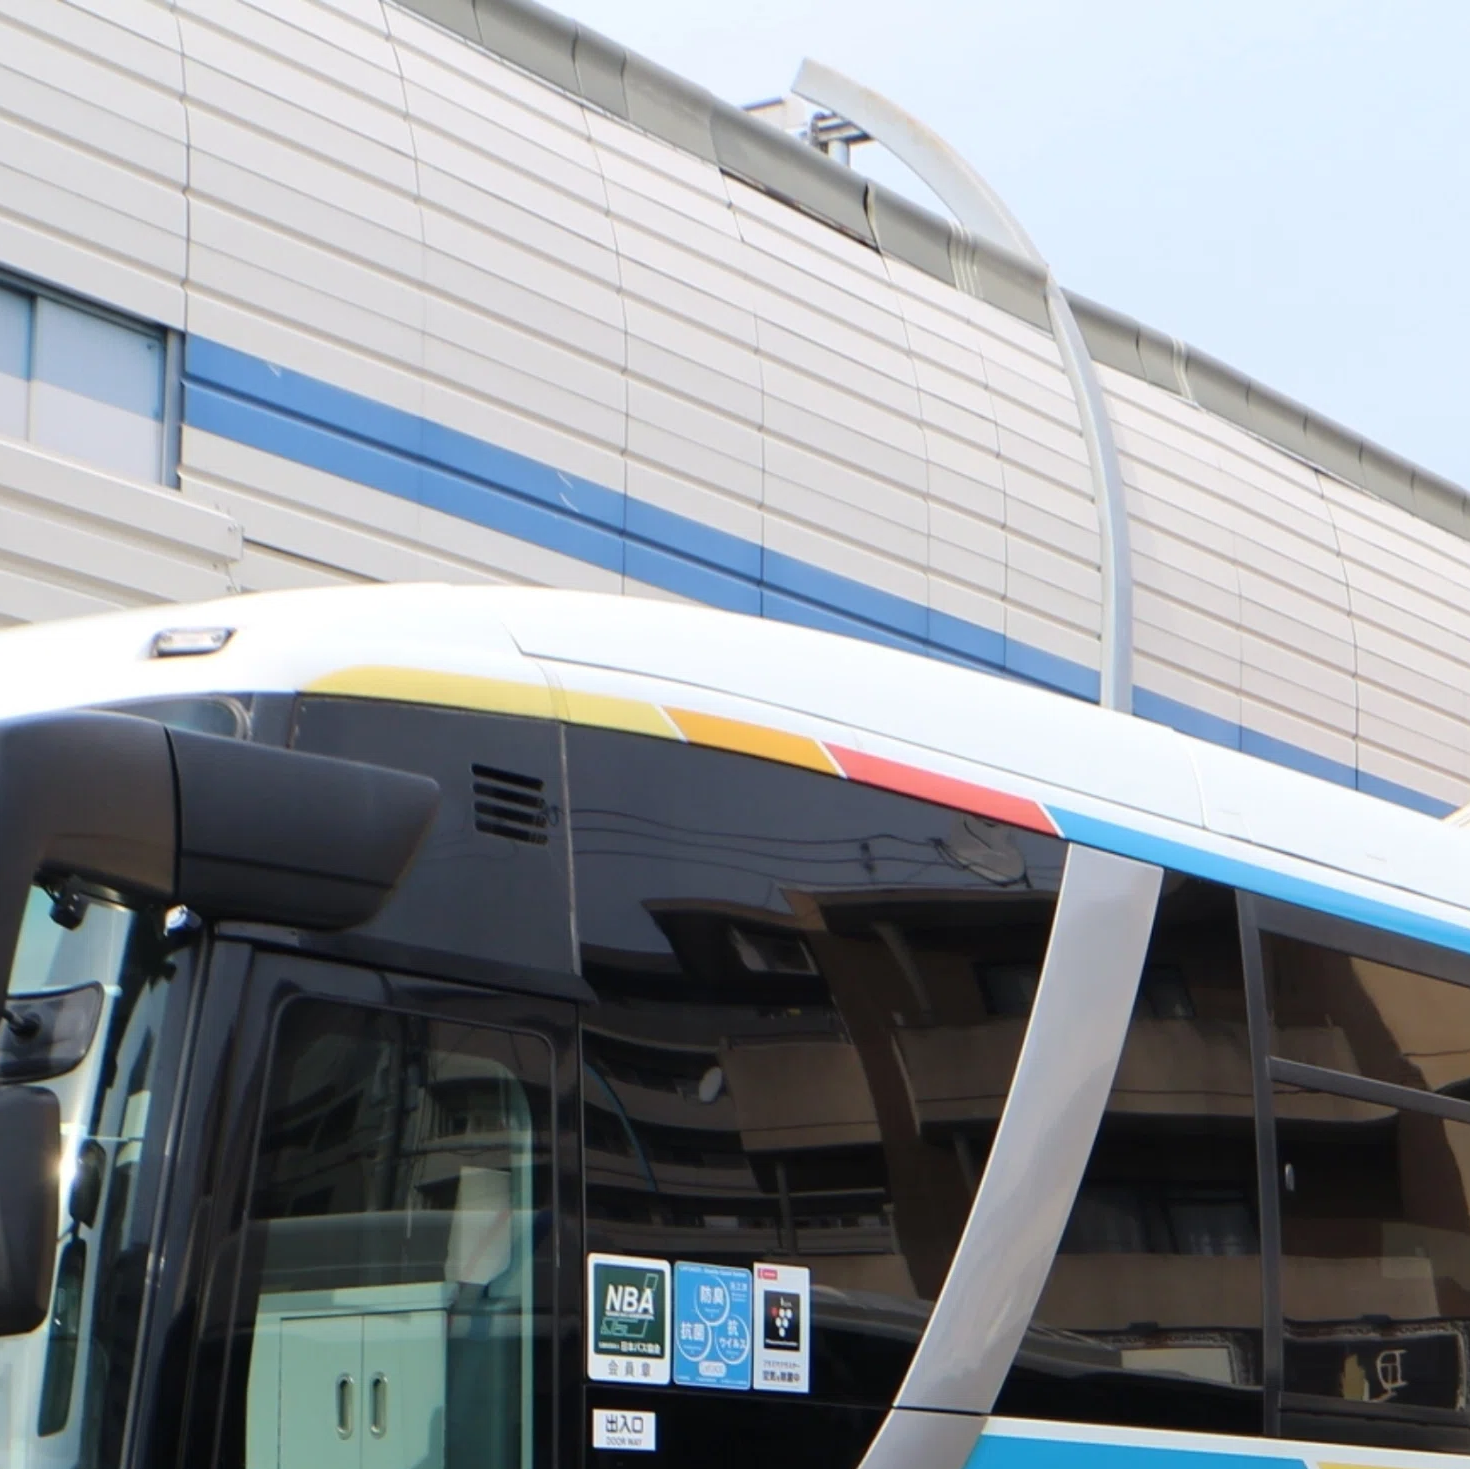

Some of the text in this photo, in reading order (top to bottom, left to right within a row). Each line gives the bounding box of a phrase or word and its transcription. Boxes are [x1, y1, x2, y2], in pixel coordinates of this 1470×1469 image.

[604, 1283, 655, 1315] NBA
[605, 1414, 644, 1433] 出入口
